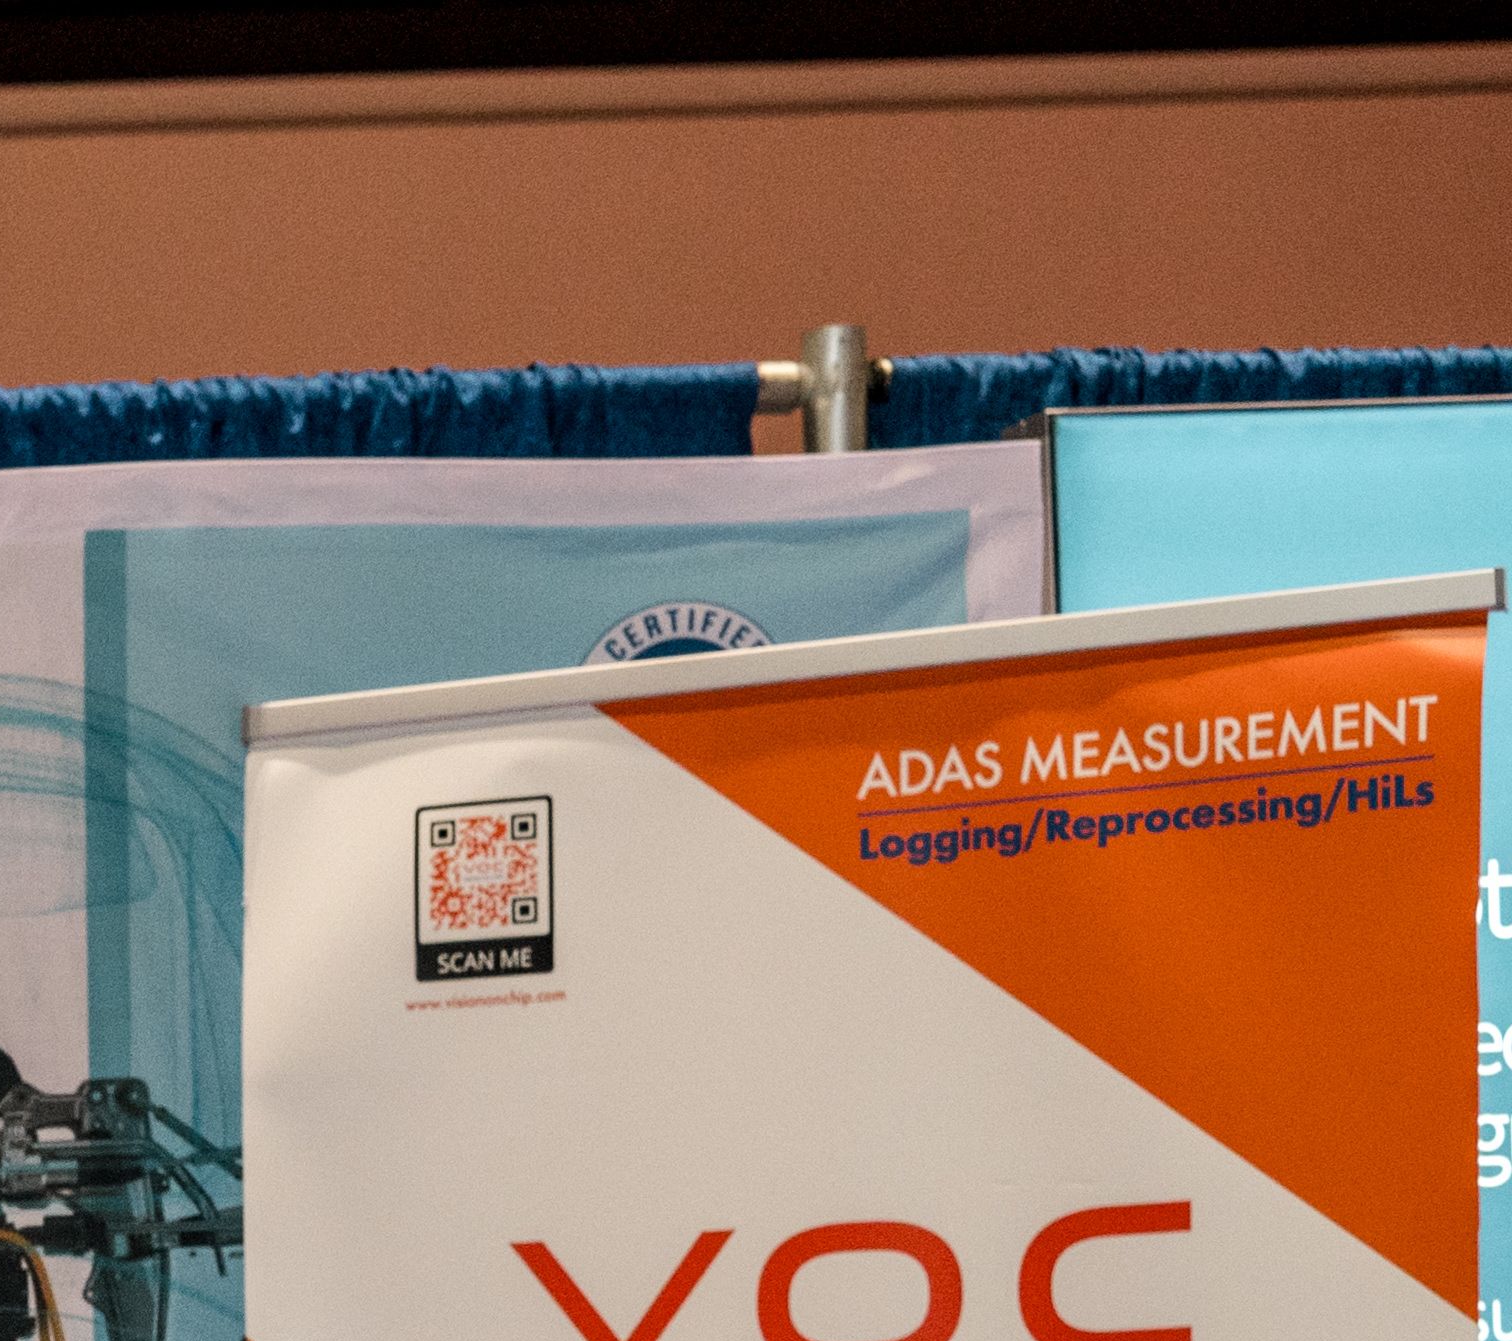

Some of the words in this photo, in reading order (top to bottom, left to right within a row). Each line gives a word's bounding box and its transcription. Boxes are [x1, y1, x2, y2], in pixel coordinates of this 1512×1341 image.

[604, 607, 765, 656] CERTIFIE
[857, 741, 1004, 801] ADAS
[1021, 694, 1439, 785] MEASUREMENT
[858, 774, 1436, 866] Logging/Reprocessing/HiLs
[436, 950, 494, 975] SCAN
[499, 947, 533, 969] ME
